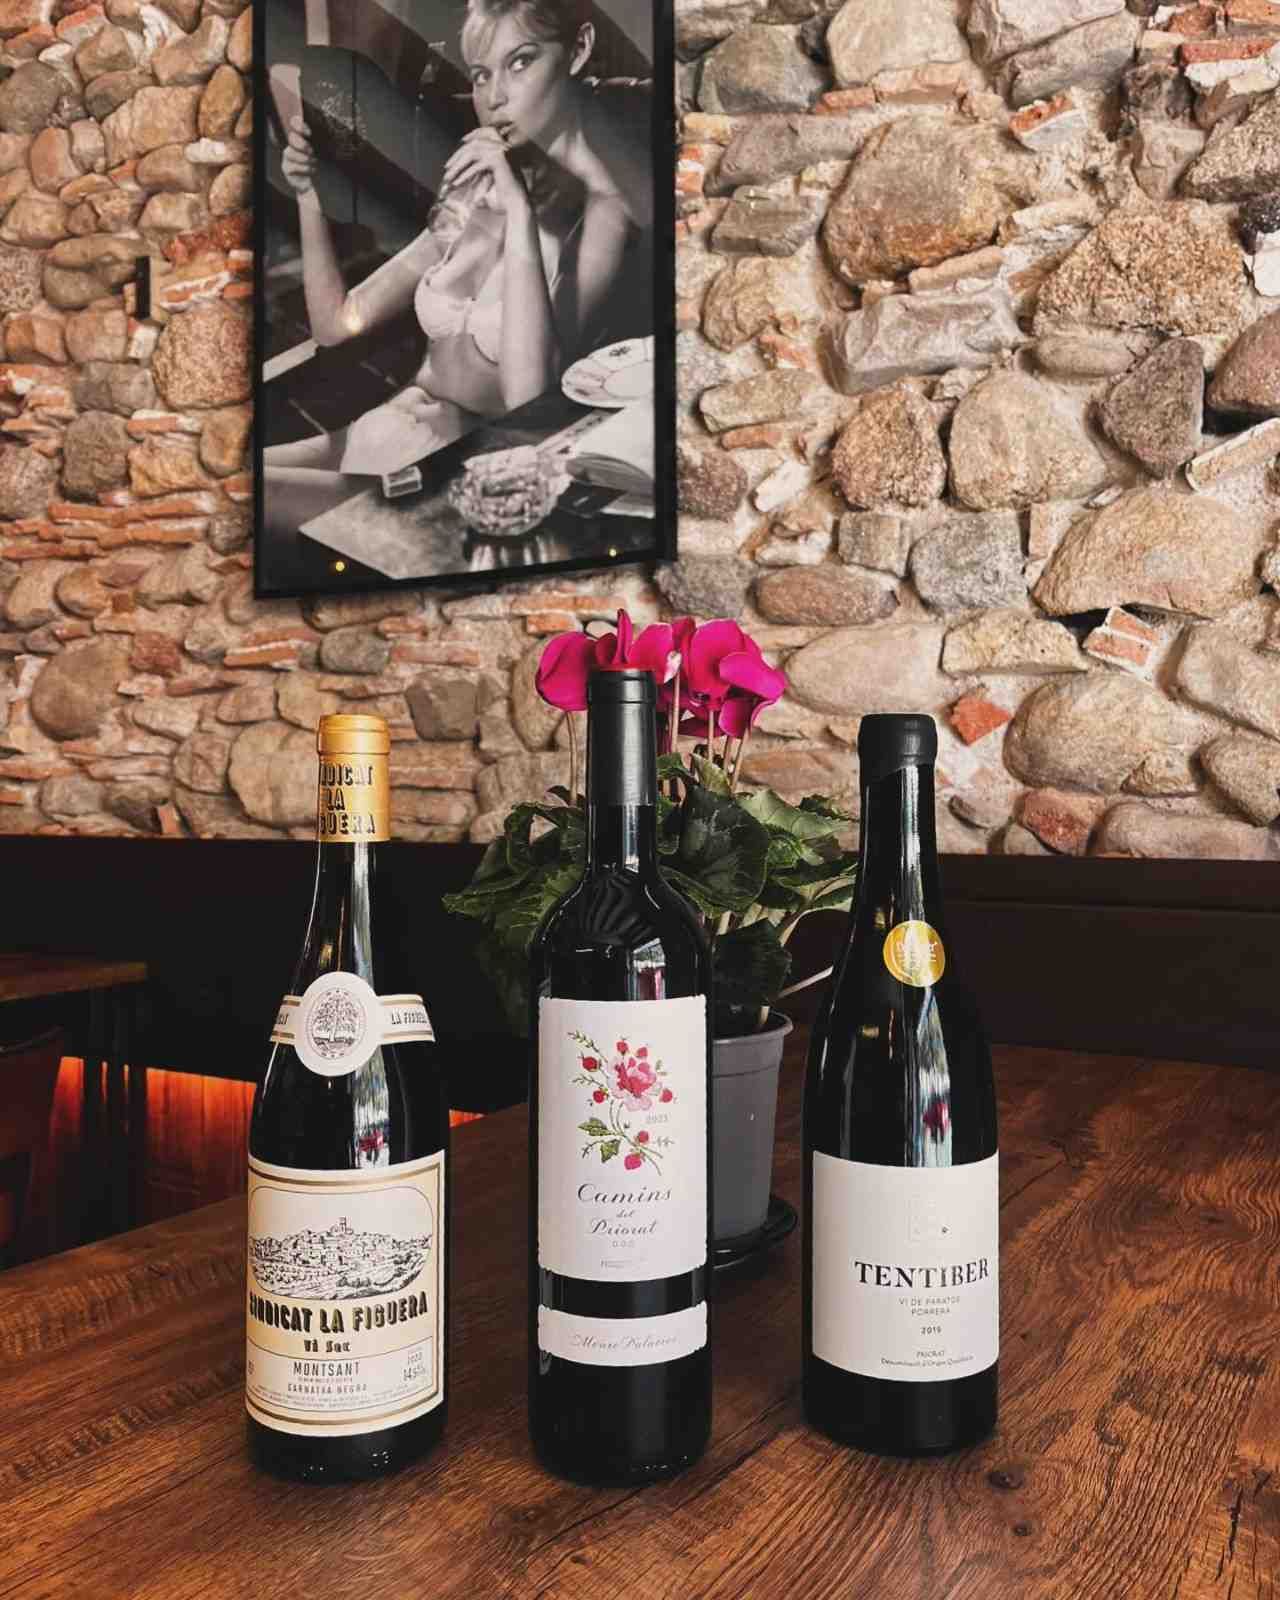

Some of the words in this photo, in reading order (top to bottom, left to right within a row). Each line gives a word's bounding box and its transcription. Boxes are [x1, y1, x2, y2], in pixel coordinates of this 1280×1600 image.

[577, 1183, 672, 1204] Camins
[616, 1208, 635, 1218] del
[591, 1219, 659, 1236] Priorat
[854, 1257, 989, 1288] TENTIBER
[911, 1297, 921, 1307] DE
[319, 1308, 345, 1333] LA
[352, 1290, 428, 1332] FIGUERA
[293, 1360, 361, 1377] MONTSANT
